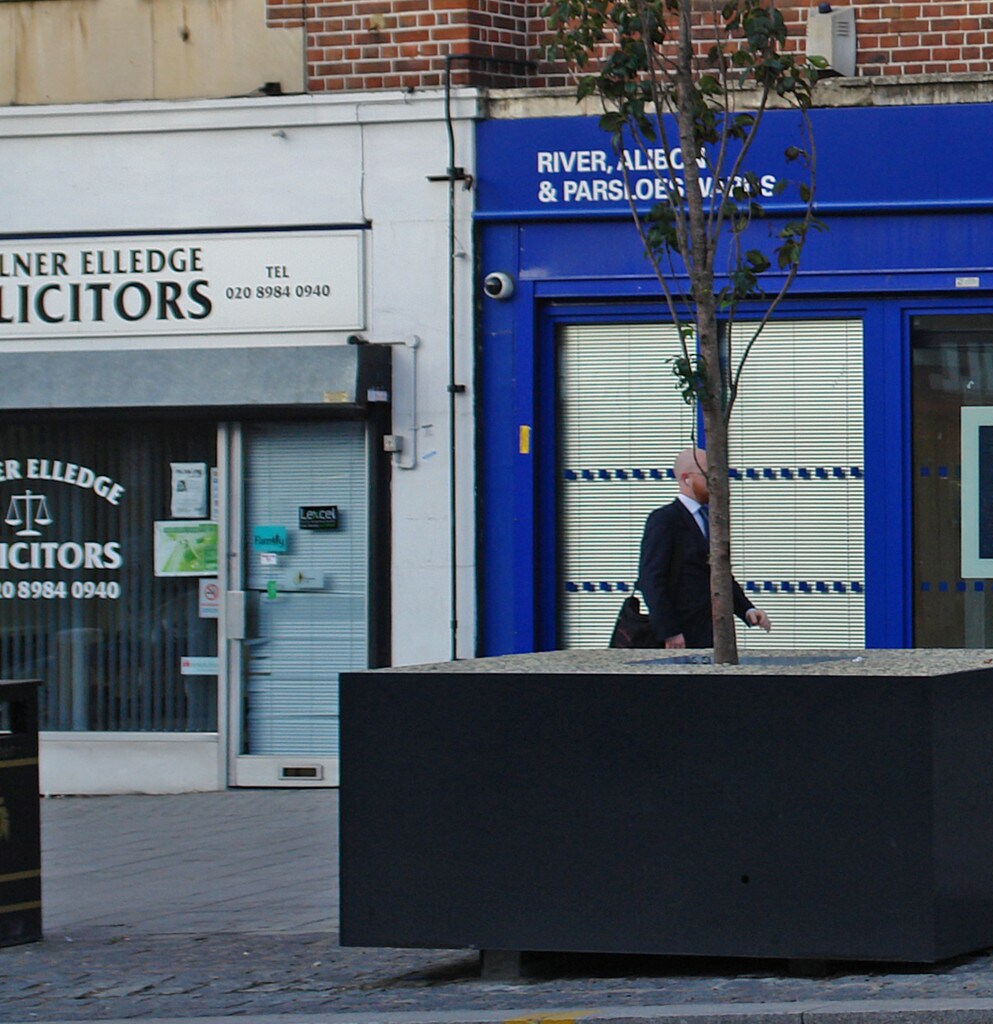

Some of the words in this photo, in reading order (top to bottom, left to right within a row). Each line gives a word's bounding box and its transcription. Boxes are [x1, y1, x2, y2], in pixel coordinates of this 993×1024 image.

[537, 150, 613, 174] RIVER,
[538, 180, 558, 203] &
[563, 178, 685, 203] PARSLOES
[80, 247, 204, 276] ELLEDGE
[265, 265, 289, 279] TEL
[225, 286, 251, 300] 020
[255, 285, 290, 300] 8984
[295, 284, 330, 298] 0940
[26, 458, 126, 505] ELLEDGE
[17, 581, 67, 599] 8984
[71, 581, 121, 599] 0940
